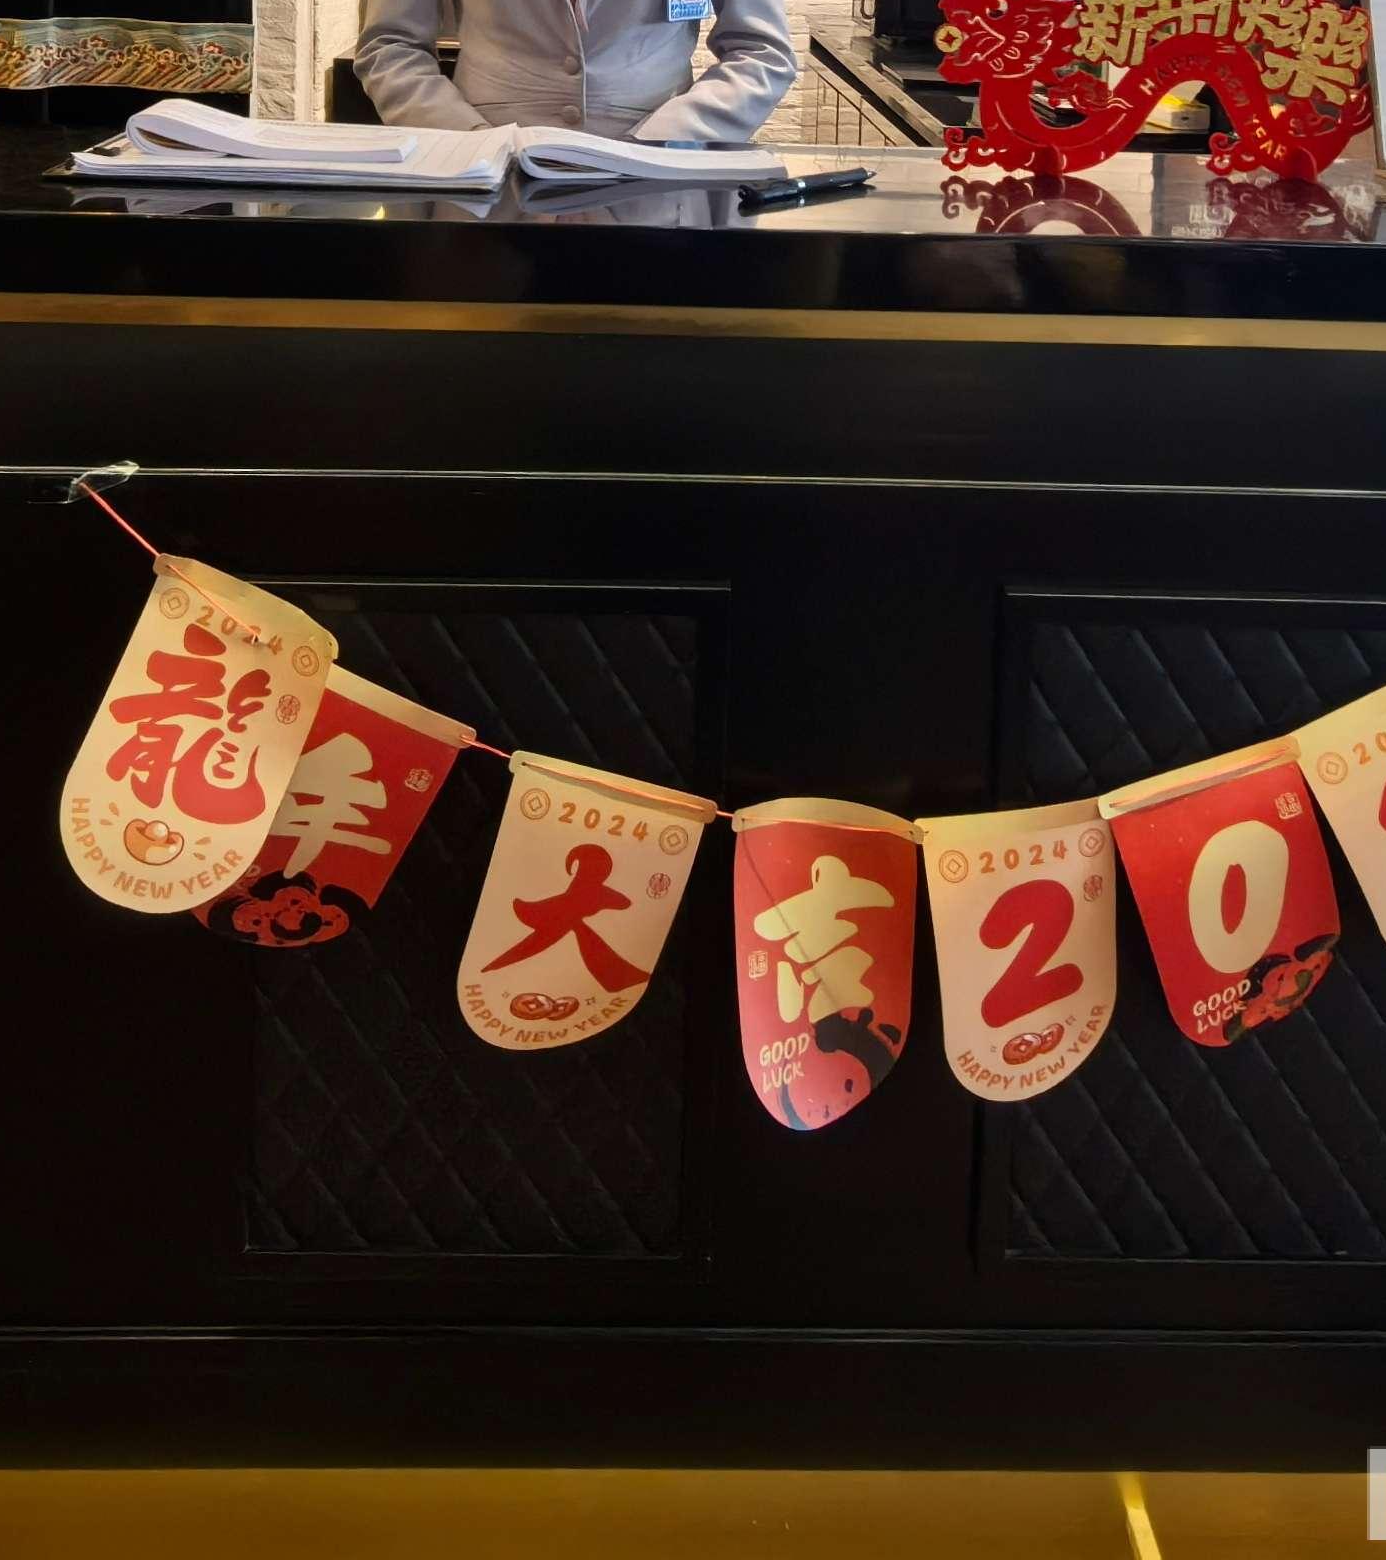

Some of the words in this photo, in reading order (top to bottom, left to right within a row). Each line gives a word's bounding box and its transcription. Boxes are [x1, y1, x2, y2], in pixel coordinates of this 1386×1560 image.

[1243, 113, 1287, 160] YEAR
[105, 622, 273, 826] 龍
[268, 731, 393, 880] 年
[480, 843, 652, 994] 大
[753, 854, 896, 1025] 吉
[978, 878, 1084, 1029] 2
[1188, 819, 1290, 975] 0
[558, 800, 650, 843] 2024
[70, 796, 114, 878] HAPPY
[113, 870, 174, 901] NEW
[181, 847, 245, 897] YEAR
[979, 839, 1069, 875] 2024
[464, 982, 514, 1038] HAPPY
[514, 1027, 569, 1044] NEW
[573, 996, 630, 1032] YEAR
[1192, 978, 1252, 1018] GOOD
[1195, 998, 1249, 1035] LUCK
[758, 1032, 811, 1067] GOOD
[956, 1048, 1016, 1092] HAPPY
[1018, 1054, 1068, 1090] NEW
[1066, 1001, 1109, 1056] YEAR
[762, 1058, 806, 1096] LUCK
